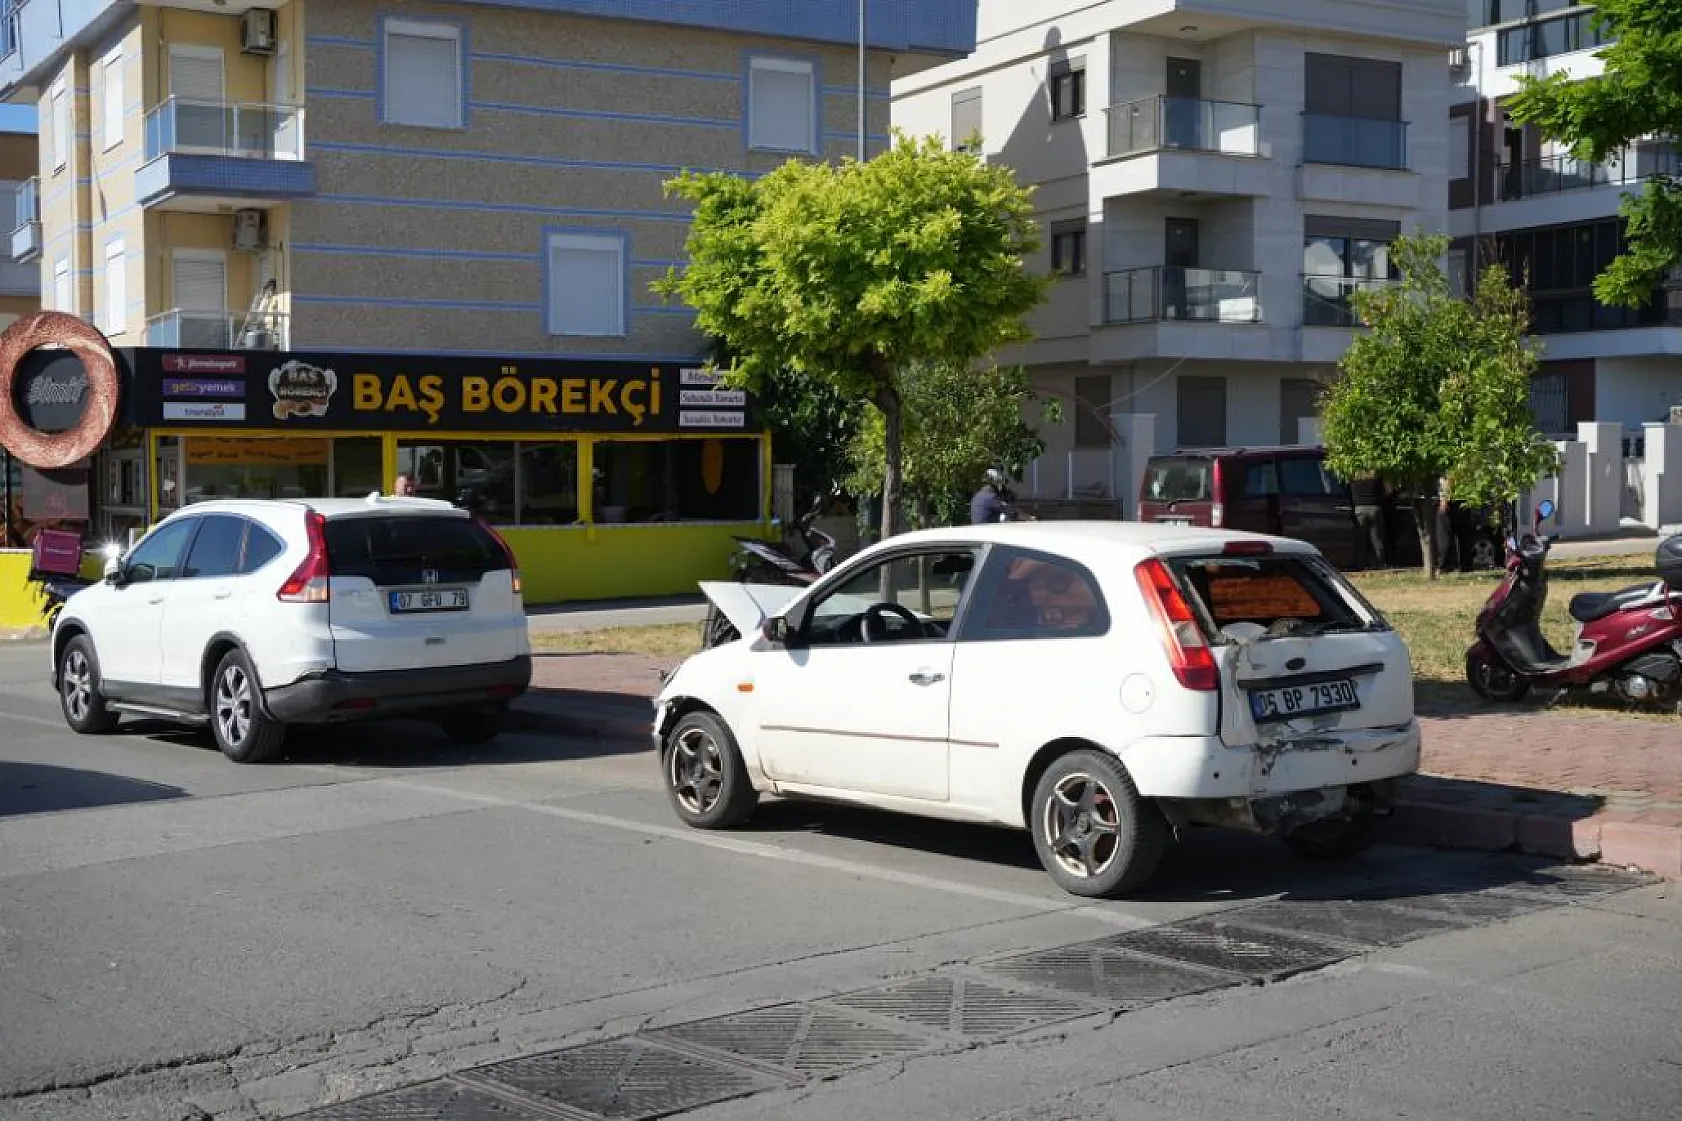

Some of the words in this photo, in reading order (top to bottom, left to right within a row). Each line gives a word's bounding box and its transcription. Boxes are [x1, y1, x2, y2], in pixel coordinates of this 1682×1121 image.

[353, 374, 444, 424] BAŞ
[462, 366, 660, 425] BÖREKÇİ
[1282, 688, 1304, 710] BP
[1309, 681, 1354, 707] 7930
